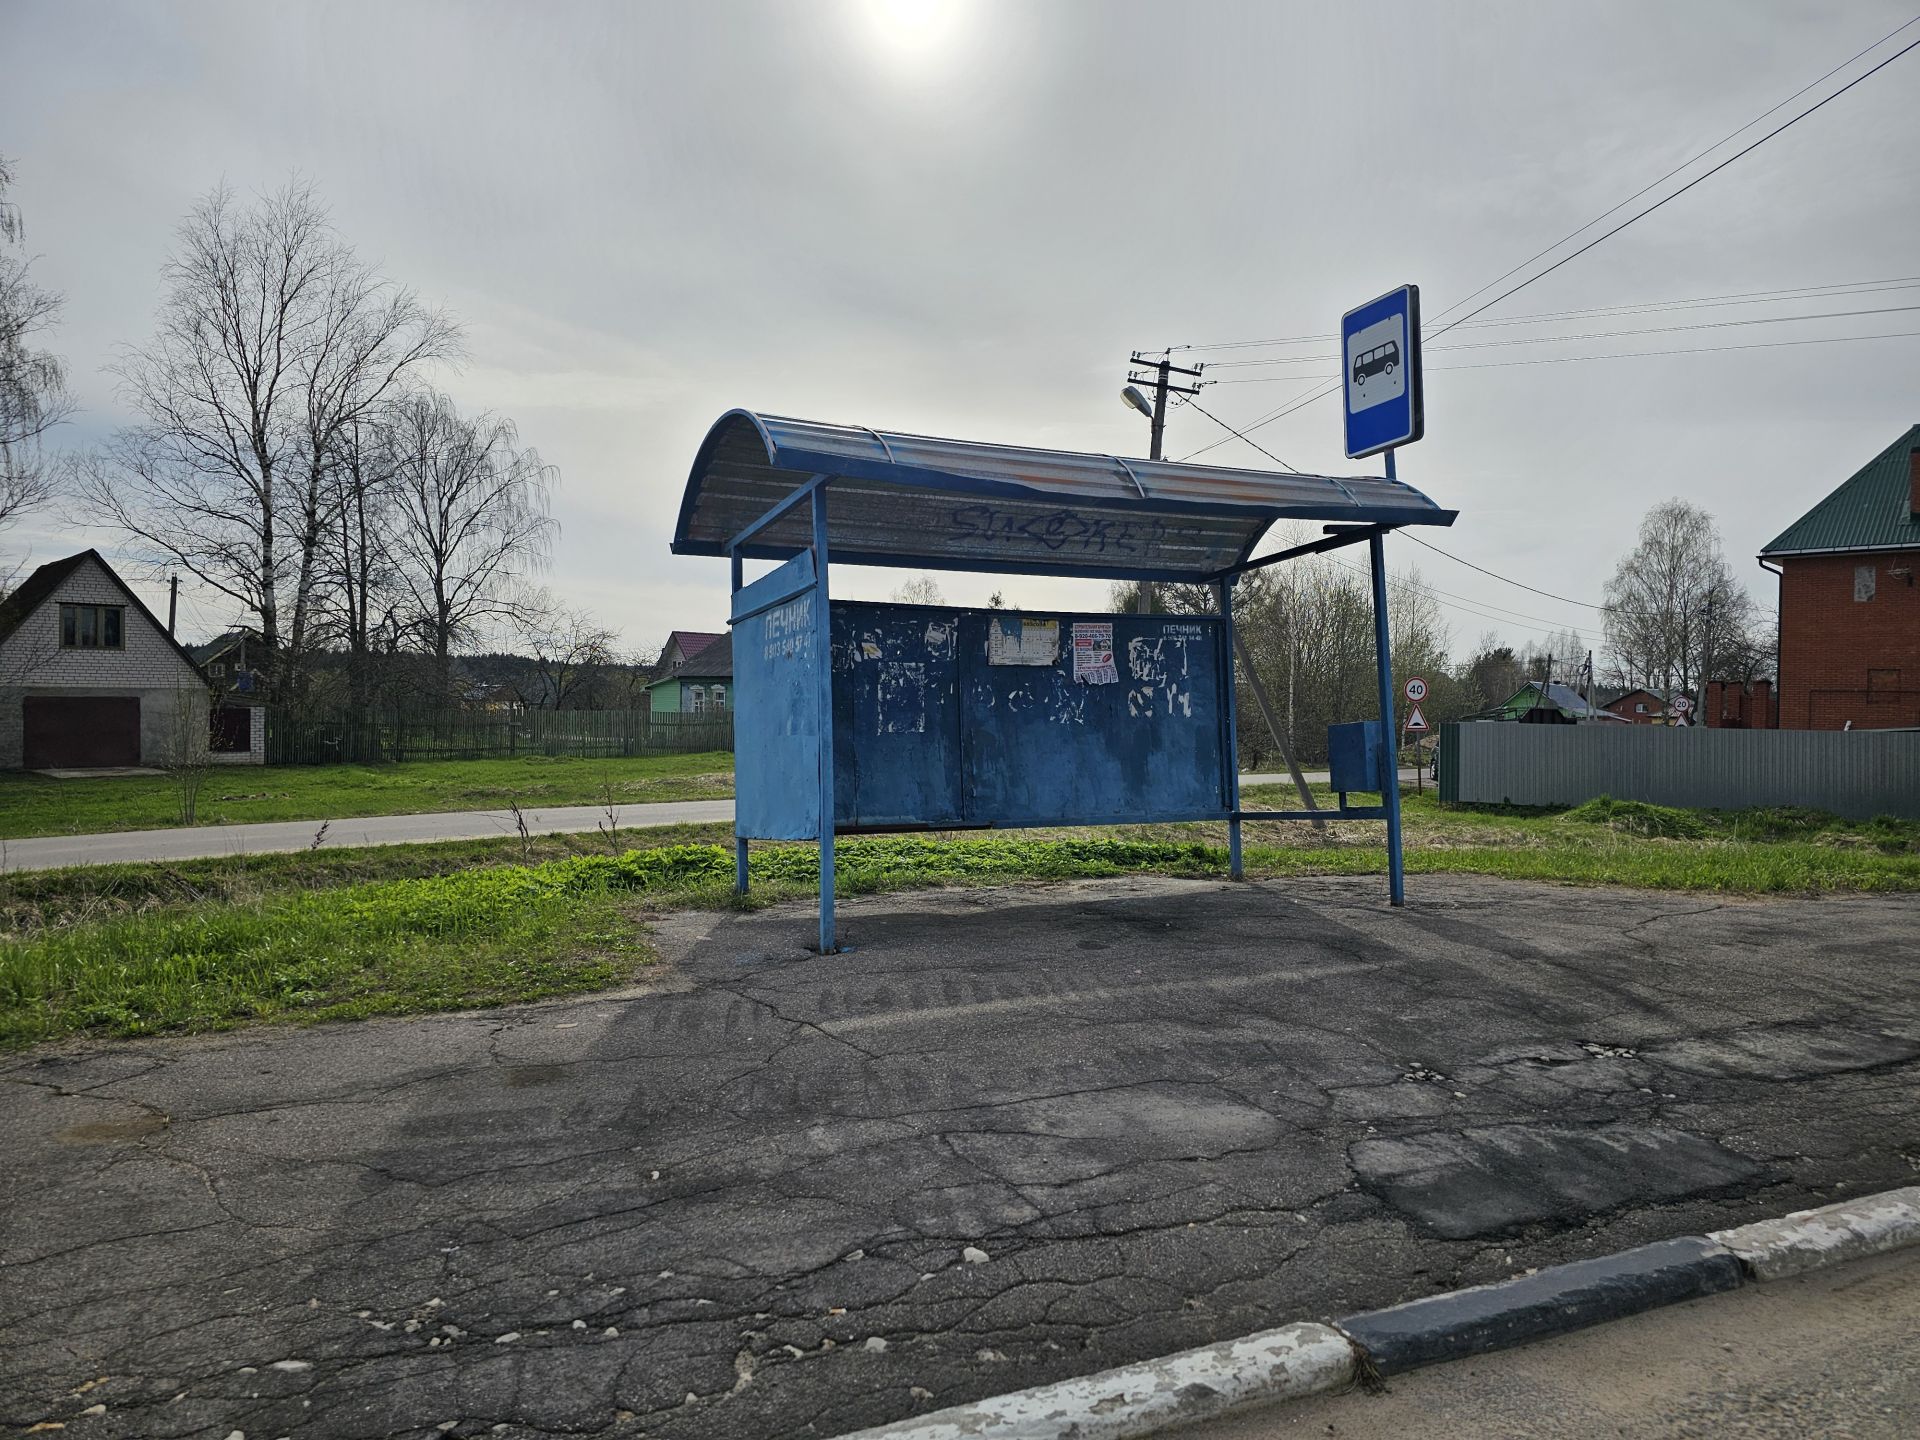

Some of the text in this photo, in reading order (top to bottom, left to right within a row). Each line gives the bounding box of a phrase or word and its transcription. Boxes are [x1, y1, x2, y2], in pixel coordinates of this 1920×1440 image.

[765, 597, 811, 641] ПЕЧНИК
[1163, 624, 1202, 634] ПЕЧНИК
[1409, 684, 1423, 694] 40
